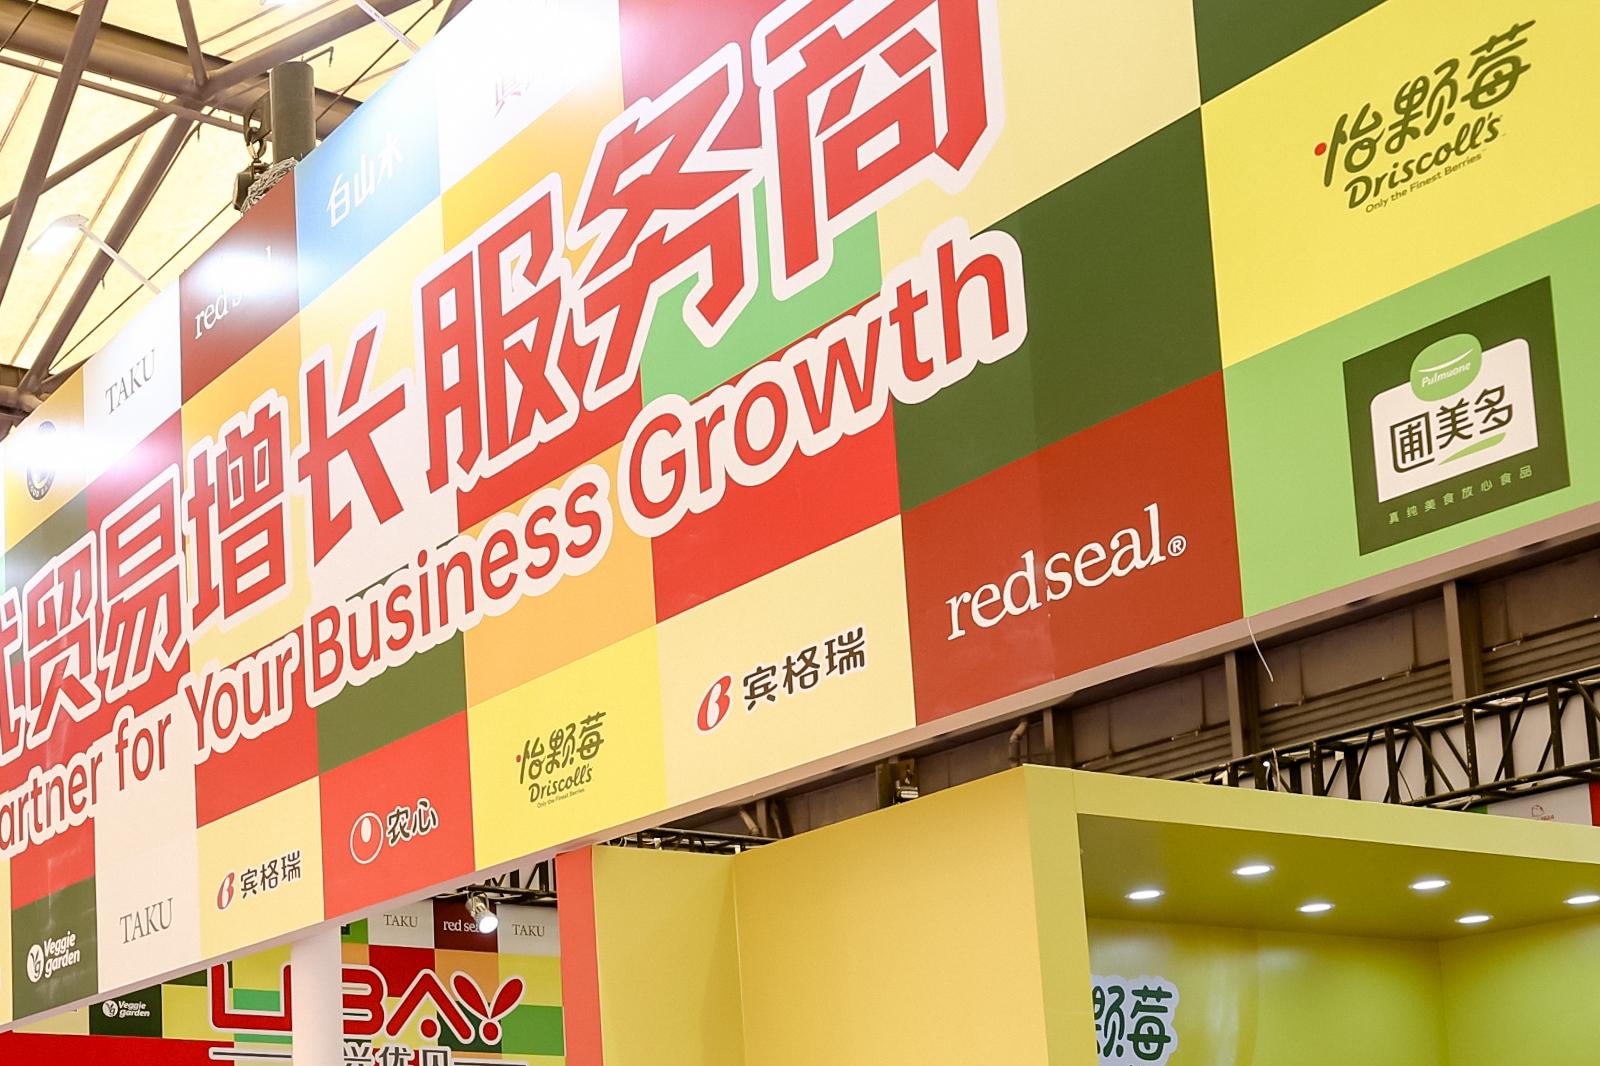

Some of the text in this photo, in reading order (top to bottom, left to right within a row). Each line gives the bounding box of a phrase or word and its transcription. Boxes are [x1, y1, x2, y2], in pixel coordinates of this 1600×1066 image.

[1314, 20, 1537, 187] 怡颗莓
[1344, 112, 1502, 209] Driscoll's
[1365, 152, 1482, 213] Only the Finest Berries
[105, 348, 157, 415] TAKU
[1389, 385, 1513, 473] 圃美多
[117, 712, 172, 792] for
[185, 646, 293, 753] Your
[311, 482, 601, 694] Business
[628, 240, 1010, 521] Growth
[743, 627, 866, 711] 宾格瑞
[516, 711, 606, 785] 怡颗莓
[528, 764, 593, 803] Driscoll's
[385, 798, 438, 848] 农心
[241, 851, 301, 899] 宾格瑞
[44, 931, 77, 958] Veggie
[119, 898, 173, 945] TAKU
[383, 914, 418, 928] TAKU
[443, 919, 460, 932] red
[512, 923, 545, 937] TAKU
[45, 946, 81, 978] garden
[118, 1000, 146, 1011] Veggie
[119, 1008, 150, 1018] garden
[1092, 984, 1173, 1061] 颗莓
